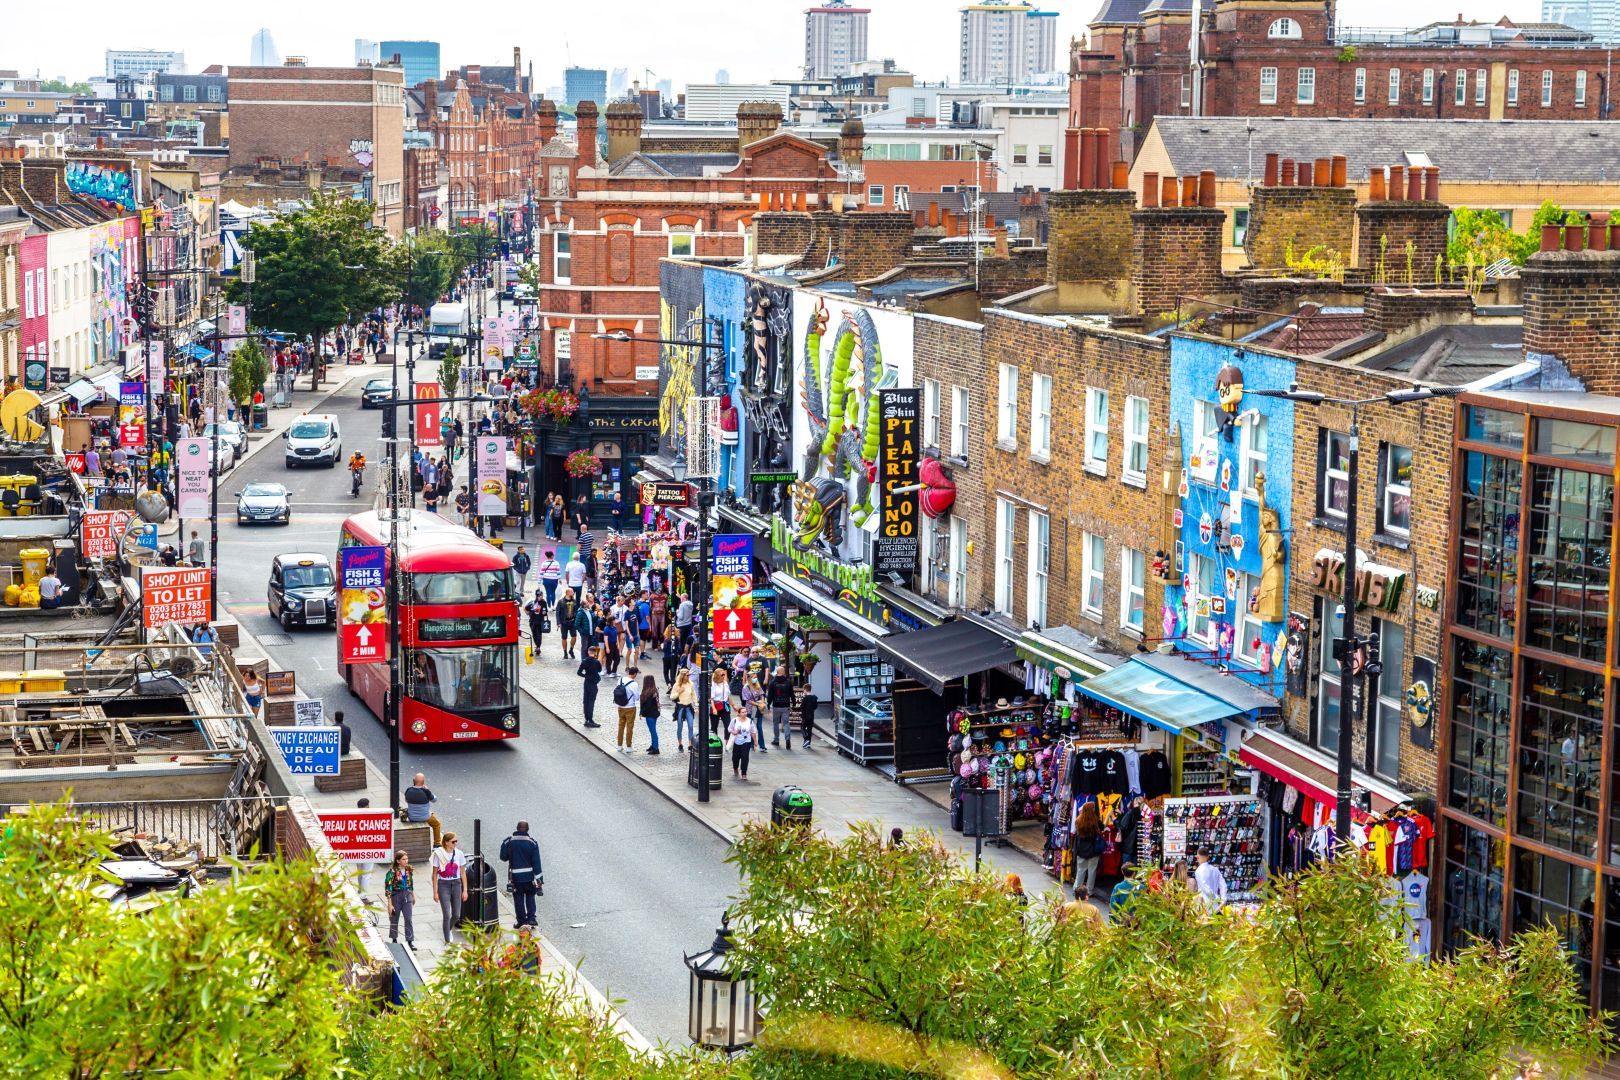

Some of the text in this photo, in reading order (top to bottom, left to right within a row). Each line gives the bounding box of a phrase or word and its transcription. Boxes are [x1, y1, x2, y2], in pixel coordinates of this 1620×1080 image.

[884, 394, 914, 404] Blue
[884, 406, 915, 418] Skin
[67, 456, 82, 471] illy
[886, 418, 900, 536] PIERCING
[901, 419, 914, 536] TATTOO
[87, 515, 108, 524] SHOP
[90, 528, 106, 538] TO
[149, 574, 176, 587] SHOP
[184, 572, 206, 583] UNIT
[1311, 557, 1387, 607] SKNS
[152, 587, 204, 603] TO LET
[150, 606, 170, 614] 0203
[172, 603, 185, 611] 617
[424, 623, 454, 632] Hampstead
[482, 620, 499, 633] 24
[729, 631, 744, 639] MIN
[298, 732, 338, 744] EXCHANGE
[320, 820, 390, 831] UREAU DE CHANGE
